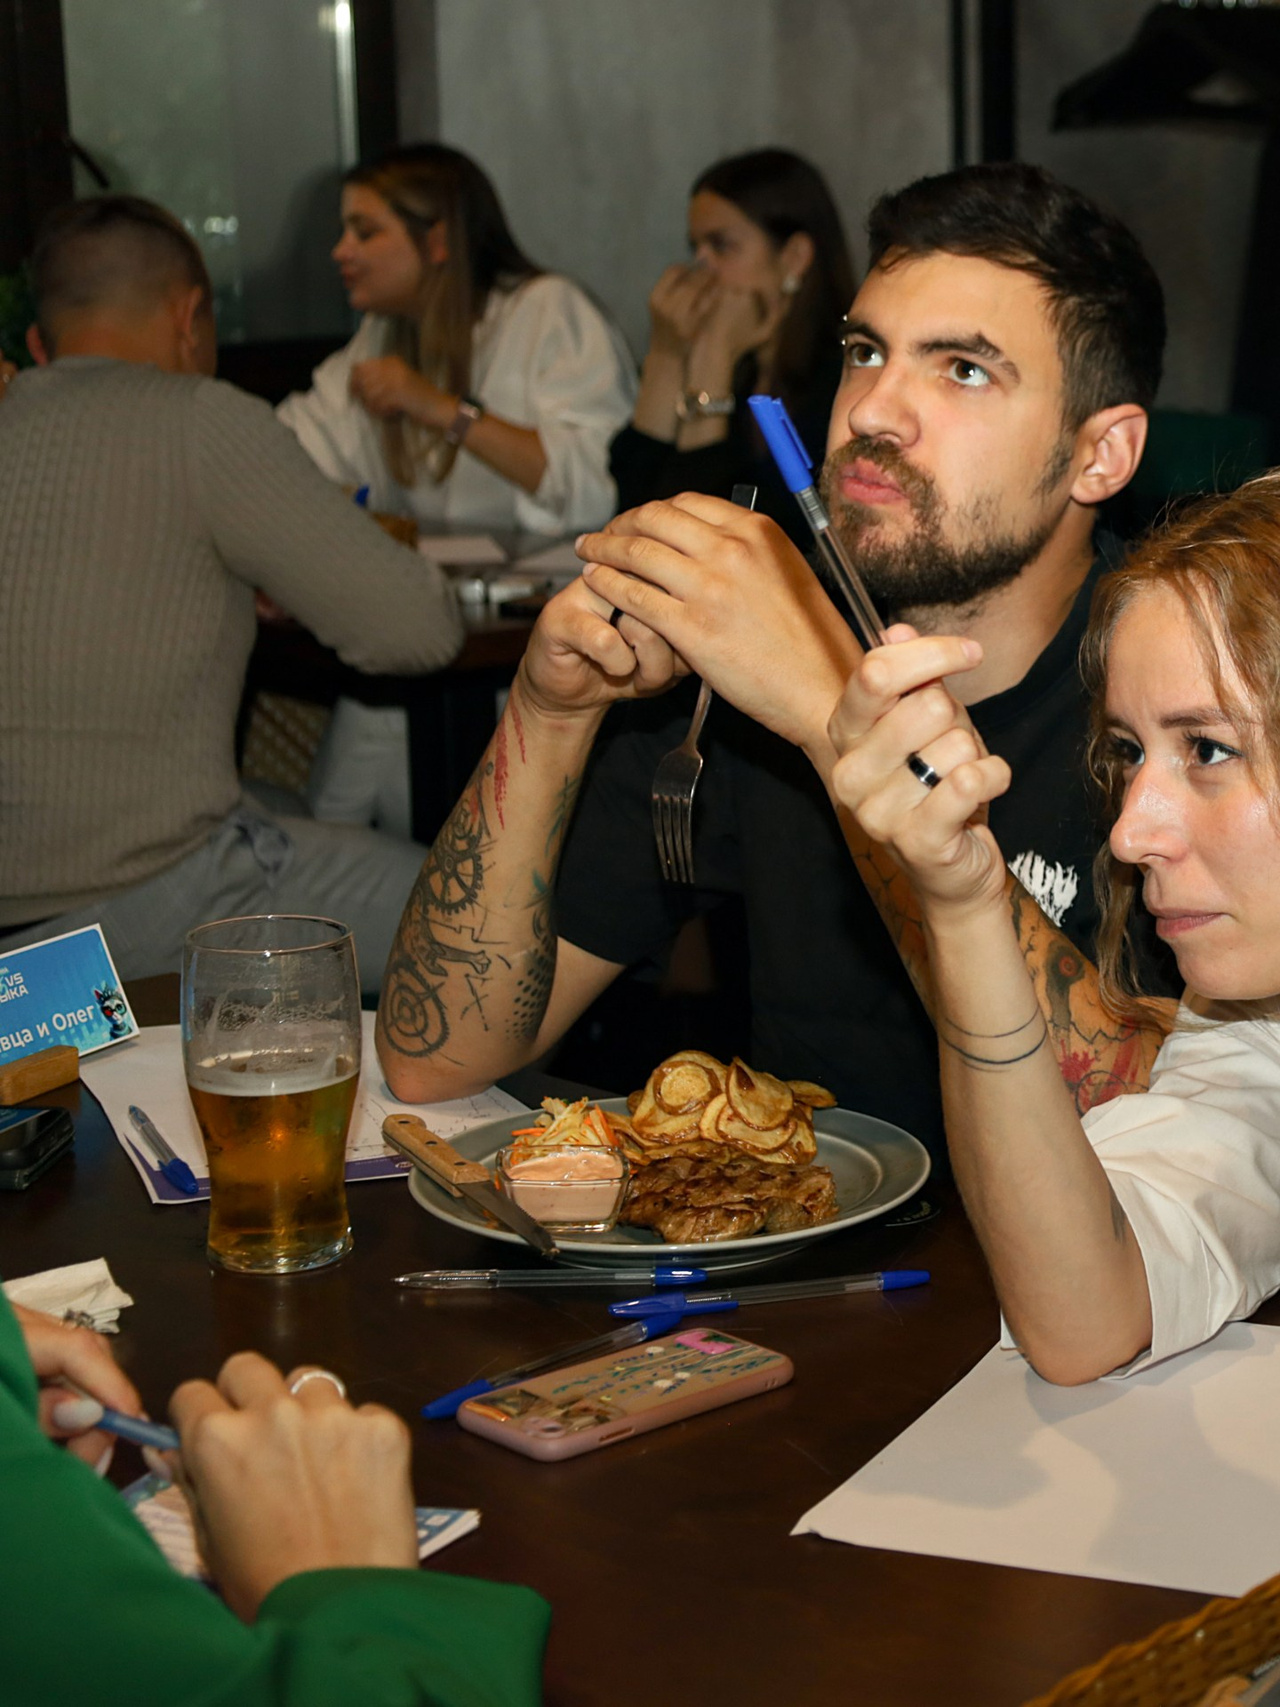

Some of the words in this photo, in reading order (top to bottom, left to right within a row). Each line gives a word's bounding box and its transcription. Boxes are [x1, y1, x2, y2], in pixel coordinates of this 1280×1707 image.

[4, 972, 24, 987] VS
[0, 1028, 34, 1053] вца
[36, 1022, 50, 1038] и
[52, 1005, 96, 1031] Олег
